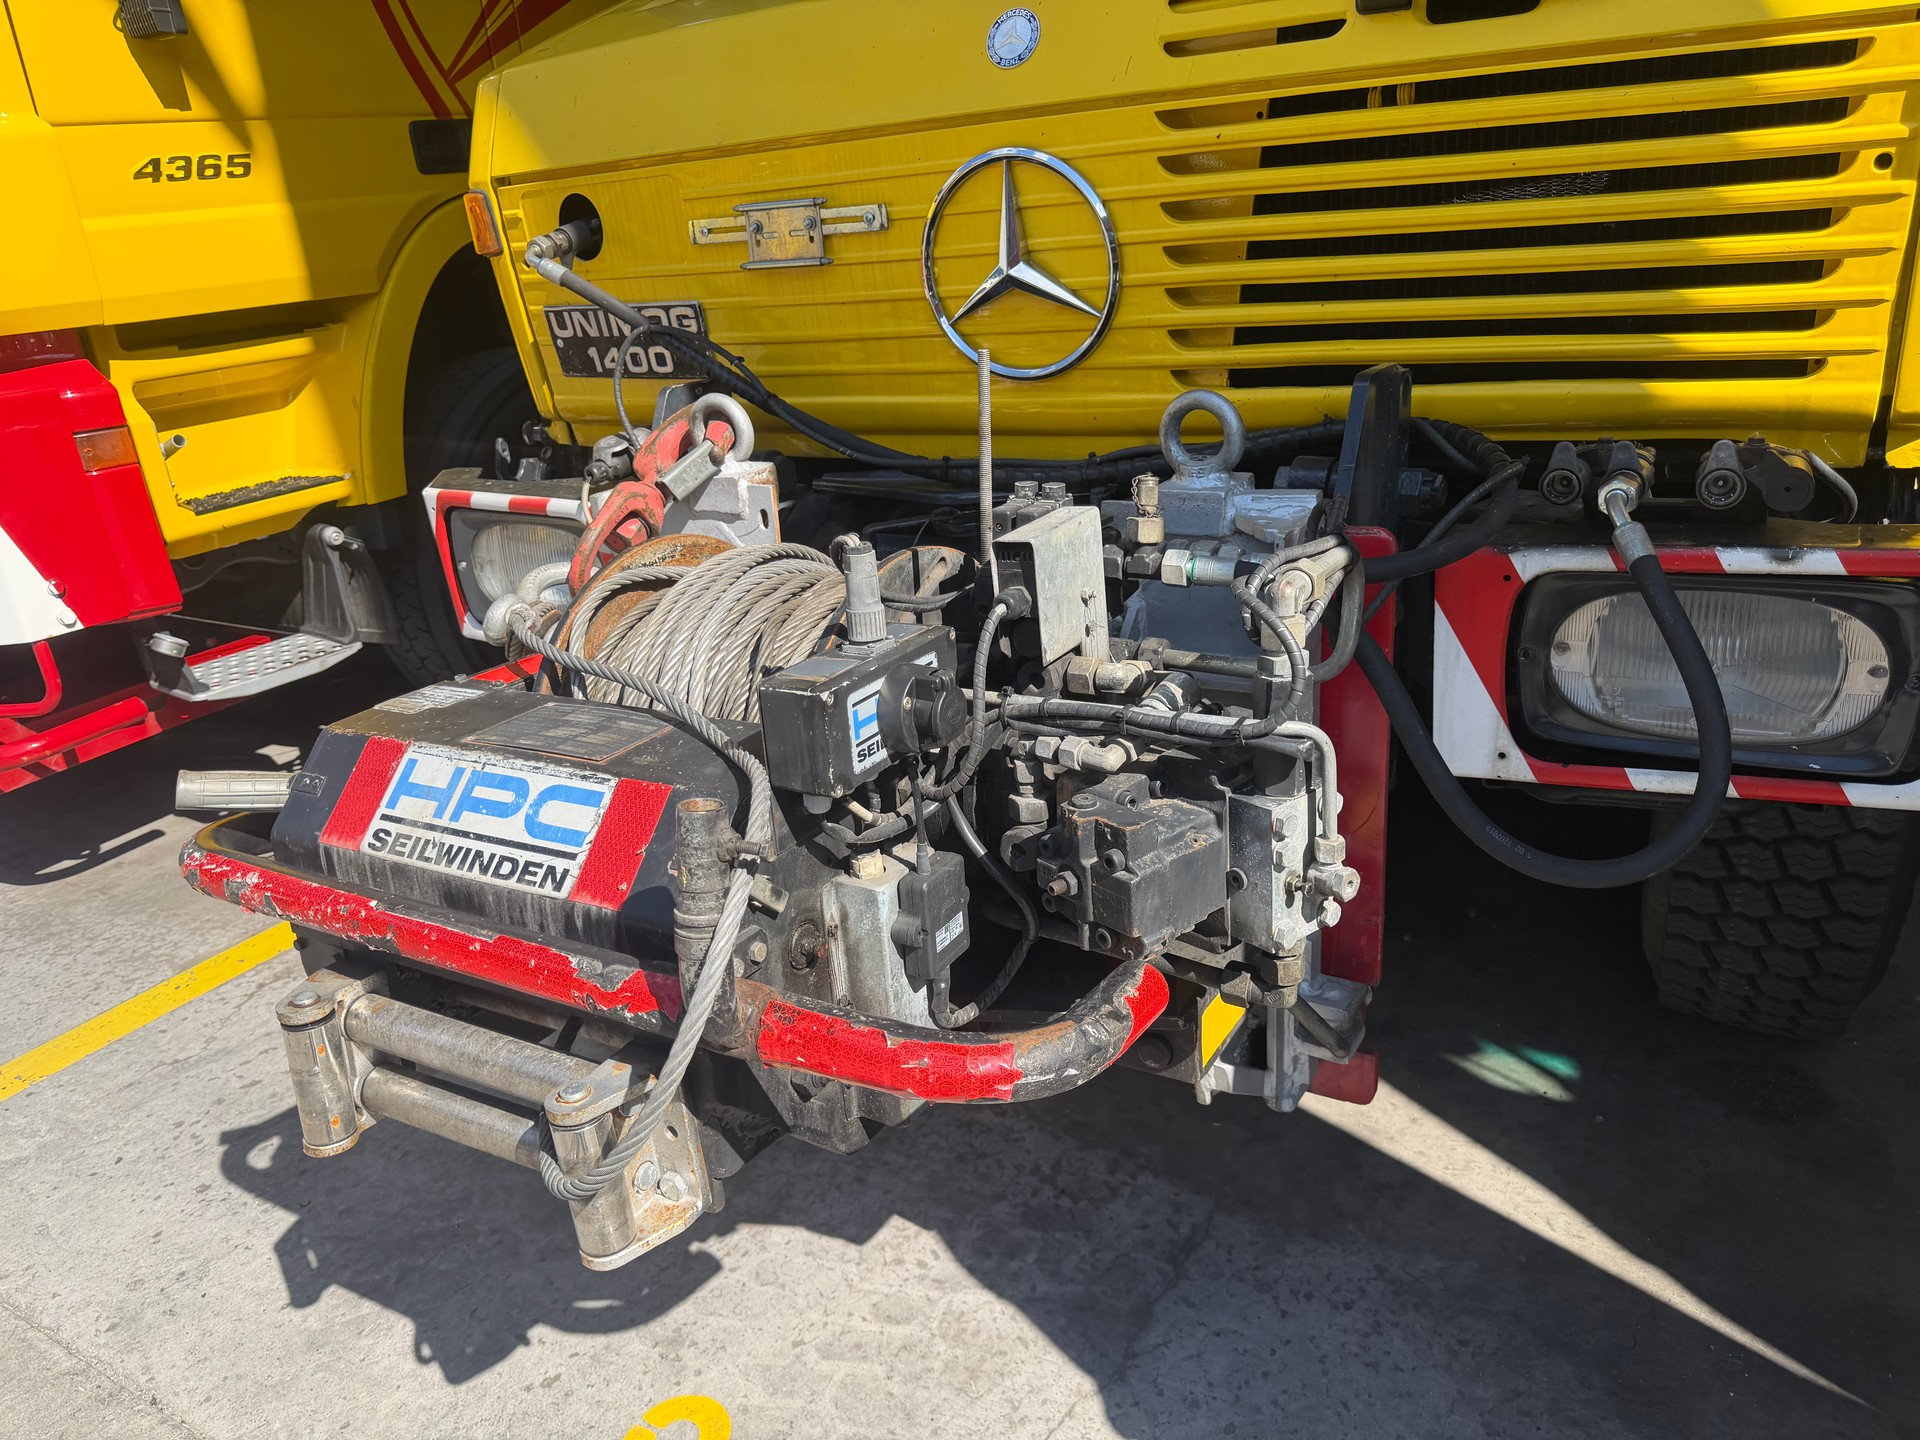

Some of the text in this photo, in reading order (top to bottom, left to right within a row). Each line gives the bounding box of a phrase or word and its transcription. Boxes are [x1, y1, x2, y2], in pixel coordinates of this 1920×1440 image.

[997, 9, 1032, 24] MERCEDES
[1000, 56, 1020, 66] BENZ
[132, 153, 252, 183] 4365
[587, 345, 674, 374] 1400
[385, 757, 606, 848] HPC
[367, 827, 571, 893] SEILWINDEN
